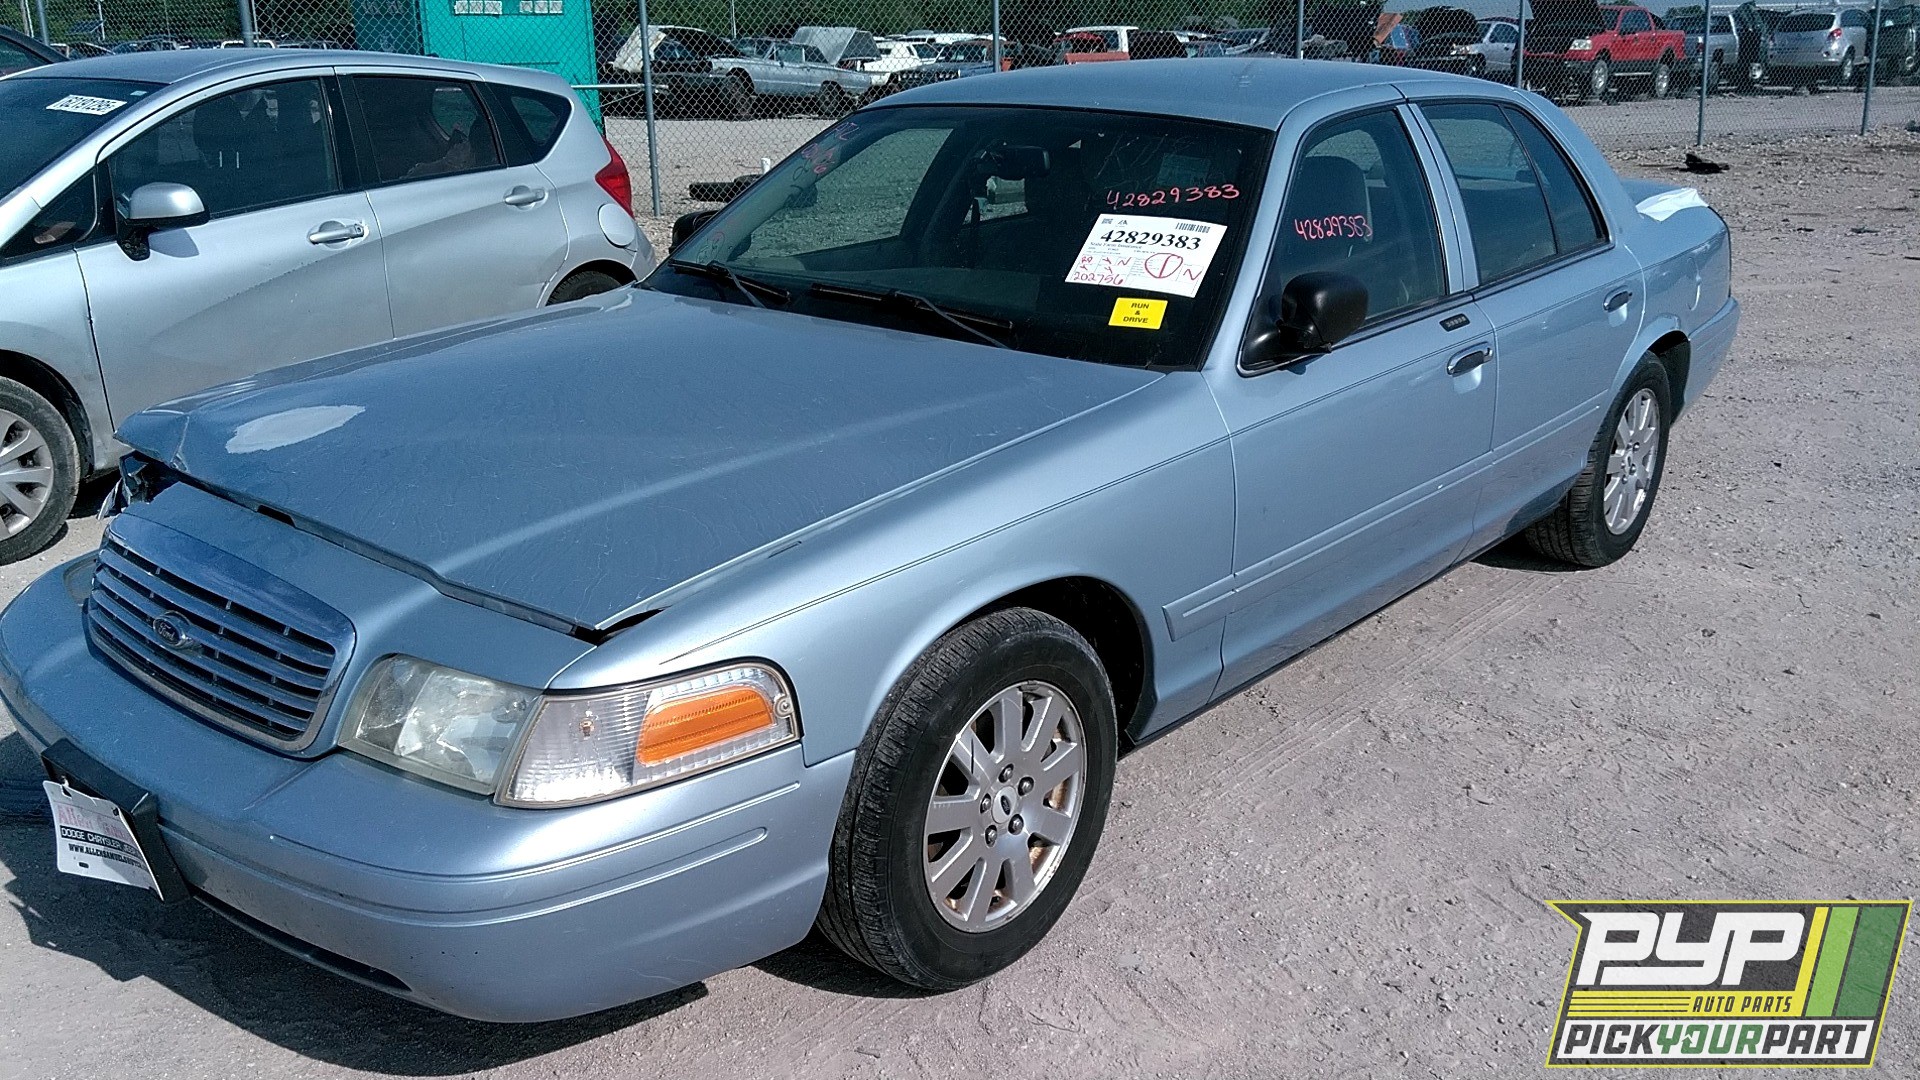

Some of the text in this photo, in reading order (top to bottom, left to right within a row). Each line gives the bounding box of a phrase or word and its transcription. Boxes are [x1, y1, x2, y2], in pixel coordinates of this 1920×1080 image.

[1106, 184, 1240, 210] 42829383
[1294, 216, 1373, 240] 42829383
[1100, 230, 1202, 250] 42829383
[1122, 316, 1149, 324] DRIVE
[61, 827, 86, 840] DODGE
[86, 832, 121, 849] CHRYSLER
